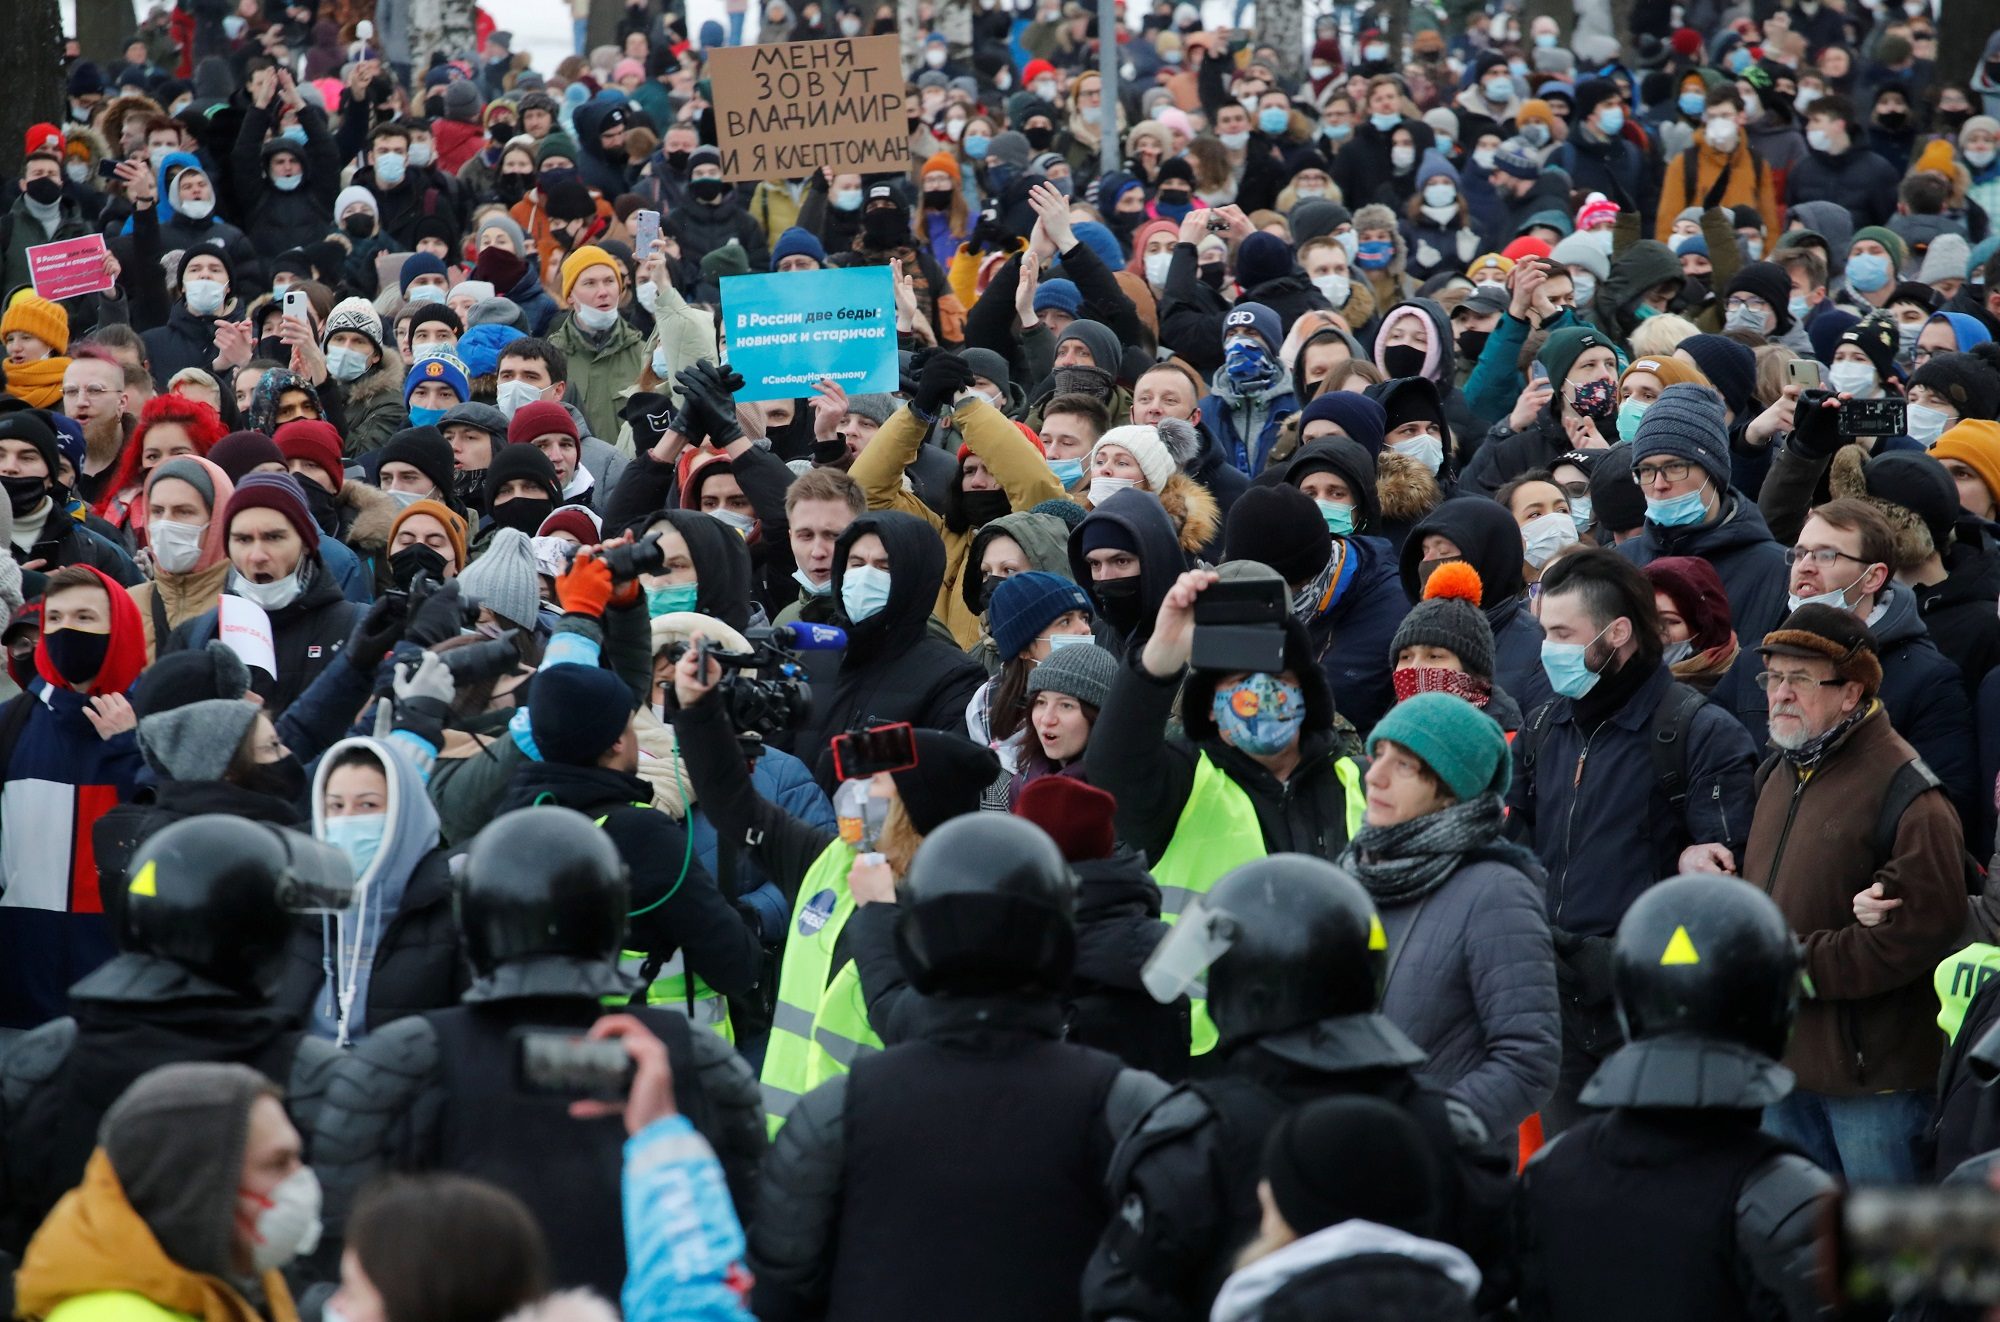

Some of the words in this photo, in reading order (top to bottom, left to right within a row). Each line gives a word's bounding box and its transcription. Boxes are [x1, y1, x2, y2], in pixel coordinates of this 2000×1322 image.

[751, 39, 855, 71] МЕНЯ
[754, 66, 879, 100] ЗОВУТ
[726, 93, 902, 137] ВЛАДИМИР
[720, 148, 740, 176] И
[752, 143, 767, 172] Я
[775, 135, 911, 170] КЛЕПТОМАН
[737, 314, 747, 328] В
[750, 312, 803, 327] России
[805, 311, 833, 324] две
[836, 307, 882, 321] беды:
[736, 332, 797, 348] новичок
[800, 332, 810, 342] и
[812, 327, 886, 343] старичок
